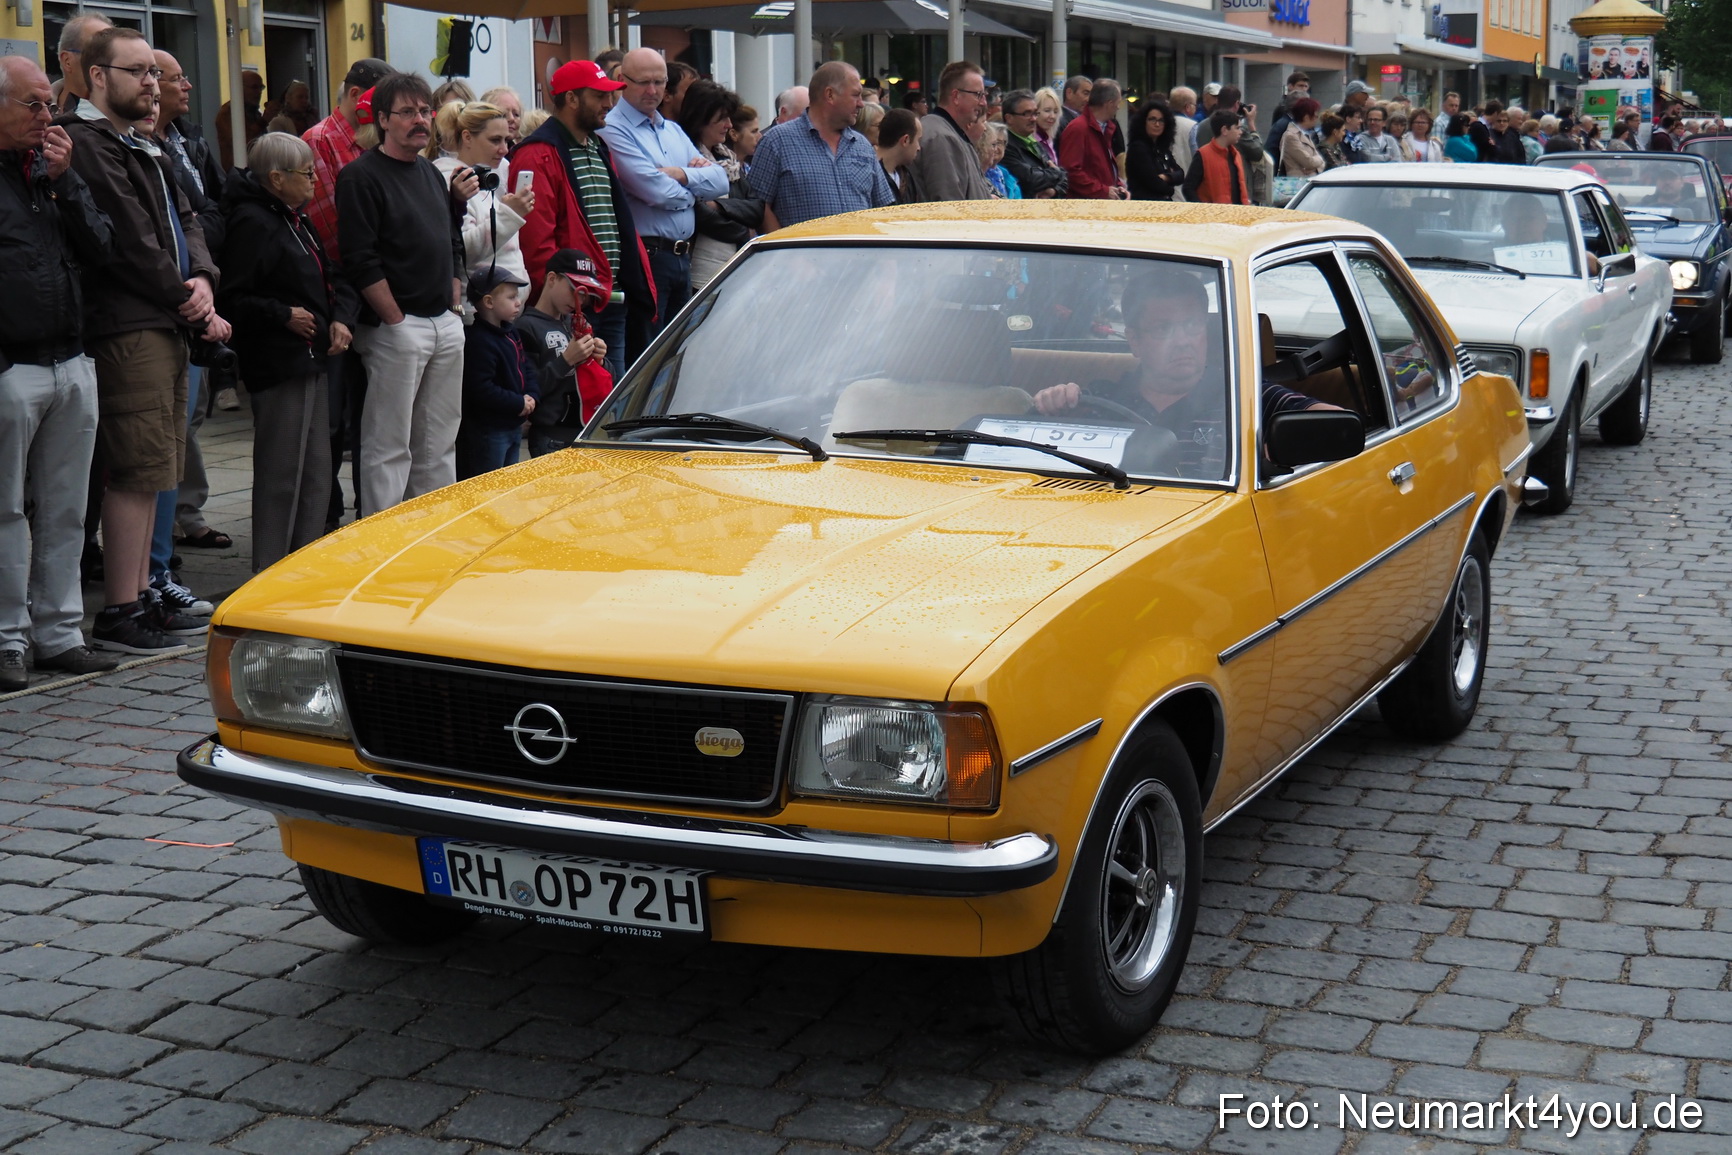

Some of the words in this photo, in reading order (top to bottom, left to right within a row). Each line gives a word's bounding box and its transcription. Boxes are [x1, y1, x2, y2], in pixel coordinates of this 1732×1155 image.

[351, 23, 365, 41] 24
[1530, 250, 1553, 259] 371
[576, 260, 591, 271] NEW
[433, 871, 443, 884] D
[447, 849, 507, 900] RH
[534, 864, 592, 911] OP
[600, 871, 698, 925] 72H
[464, 902, 492, 914] Dengler
[536, 914, 592, 930] Spalt-Mosbach
